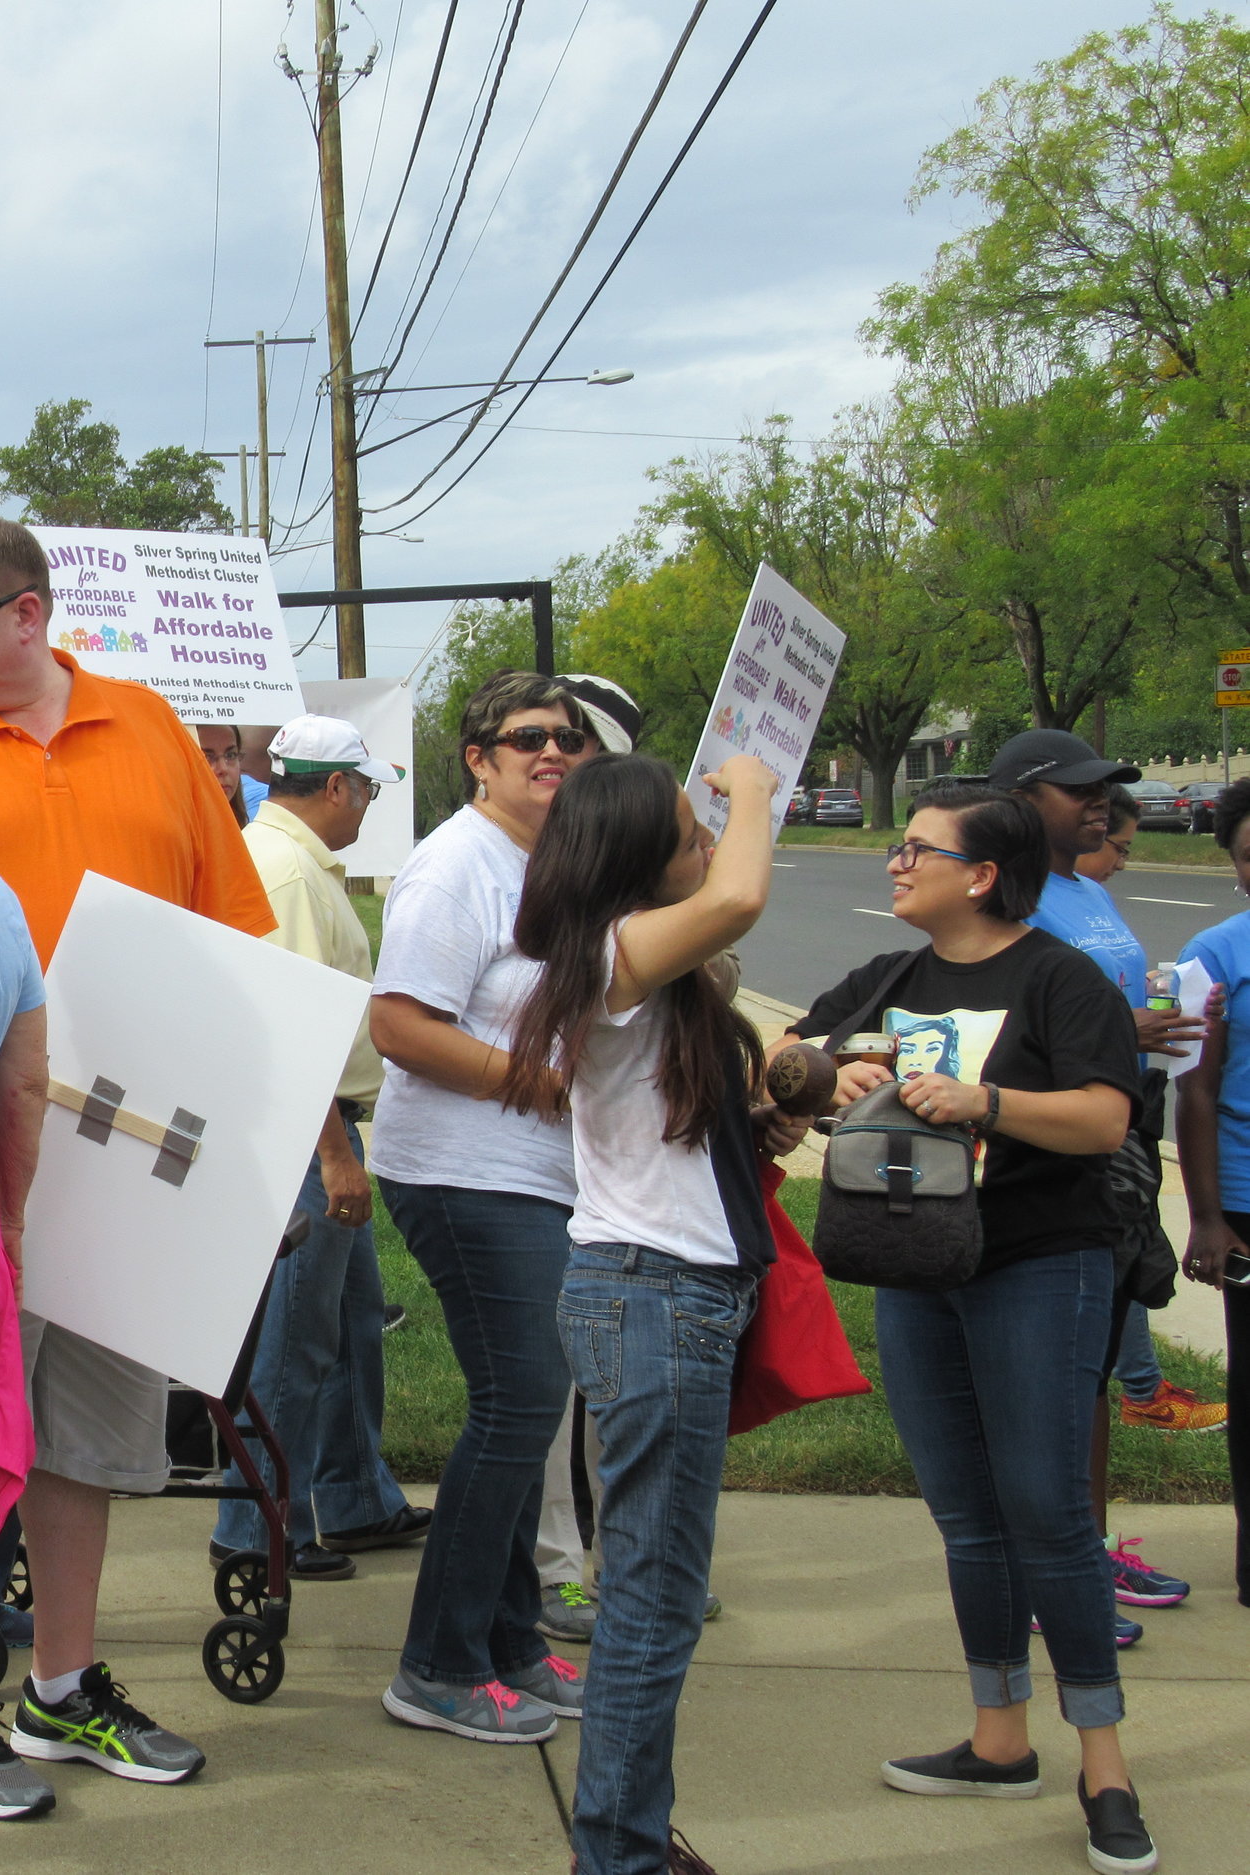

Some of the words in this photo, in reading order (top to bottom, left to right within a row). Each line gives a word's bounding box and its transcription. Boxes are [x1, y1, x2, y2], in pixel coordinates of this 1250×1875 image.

[47, 546, 126, 572] UNITED
[134, 544, 171, 558] Silver
[175, 546, 217, 564] Spring
[220, 549, 261, 565] United
[78, 566, 99, 588] for
[145, 565, 211, 580] Methodist
[214, 568, 258, 584] Cluster
[51, 588, 136, 603] AFFORDABLE
[157, 589, 217, 610] Walk
[222, 593, 254, 612] for
[66, 603, 126, 617] HOUSING
[153, 617, 273, 640] Affordable
[751, 600, 785, 646] UNITED
[752, 631, 766, 656] for
[790, 615, 806, 640] Silver
[805, 628, 821, 658] Spring
[820, 641, 837, 667] United
[170, 644, 267, 671] Housing
[734, 650, 770, 687] AFFORDABLE
[783, 643, 809, 677] Methodist
[807, 664, 825, 690] Cluster
[151, 677, 189, 687] United
[193, 678, 251, 690] Methodist
[253, 680, 293, 691] Church
[733, 673, 759, 703] HOUSING
[160, 692, 199, 704] eorgia
[202, 693, 245, 703] Avenue
[773, 677, 797, 713] Walk
[795, 696, 811, 723] for
[173, 706, 213, 719] Spring,
[216, 708, 235, 717] MD
[755, 710, 802, 760] Affordable
